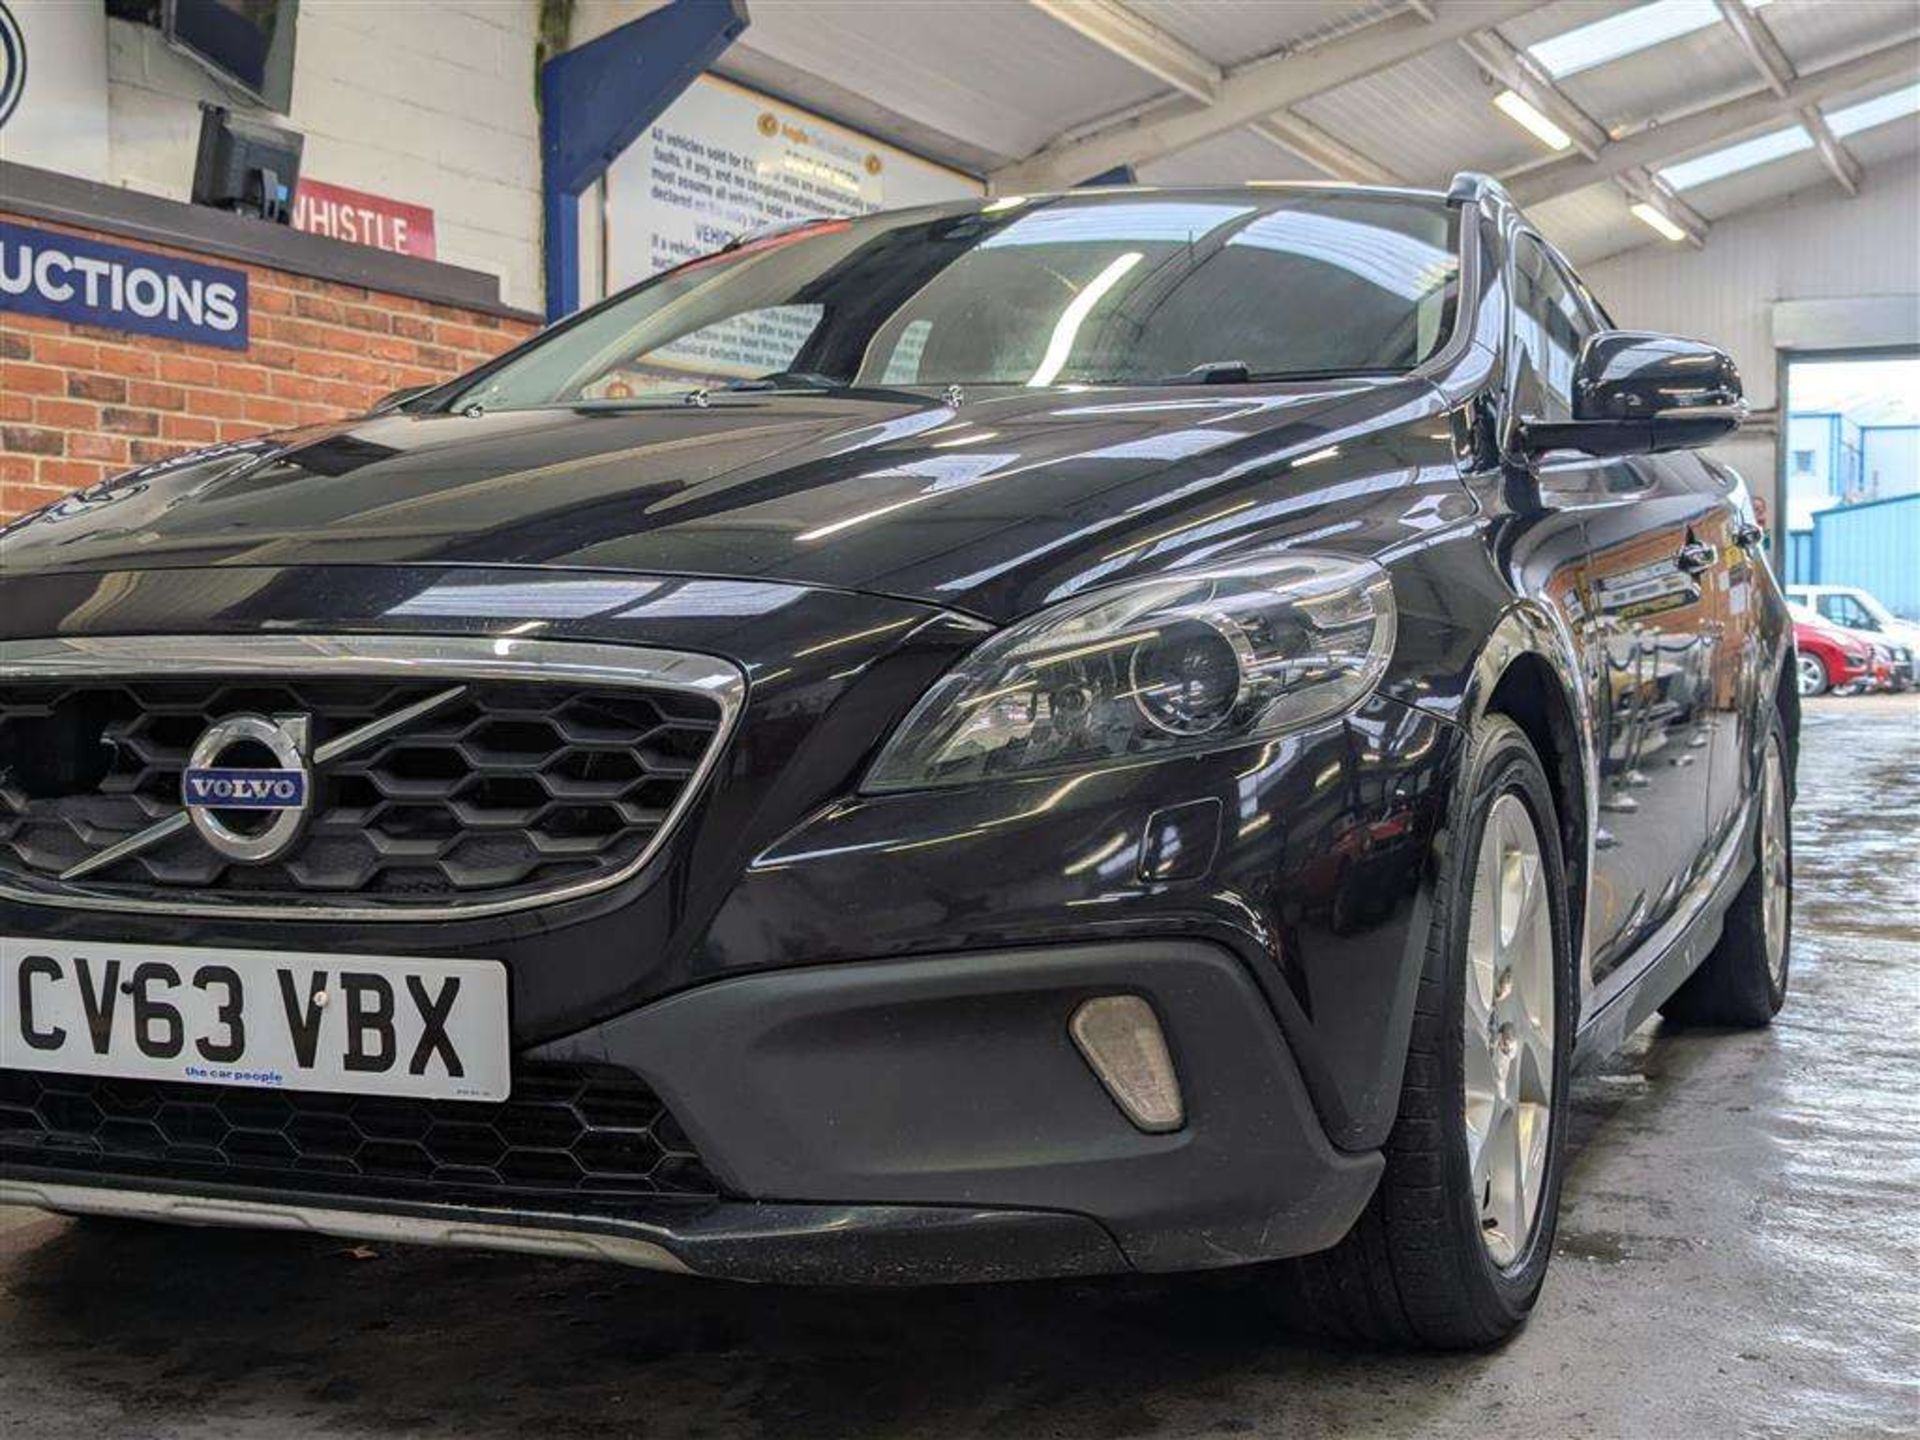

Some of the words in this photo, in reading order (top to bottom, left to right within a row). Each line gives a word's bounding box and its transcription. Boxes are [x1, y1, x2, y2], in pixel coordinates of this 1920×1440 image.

[652, 127, 664, 142] All
[667, 134, 704, 156] vehicles
[707, 147, 726, 163] sold
[729, 152, 741, 167] for
[652, 167, 676, 186] must
[678, 176, 713, 196] assume
[716, 170, 731, 184] and
[651, 186, 692, 209] declared
[0, 241, 238, 331] UCTIONS
[192, 778, 296, 801] VOLVO
[18, 955, 245, 1063] CV63
[276, 970, 464, 1078] VBX
[185, 1066, 207, 1079] the
[210, 1070, 233, 1080] car
[234, 1072, 283, 1085] people
